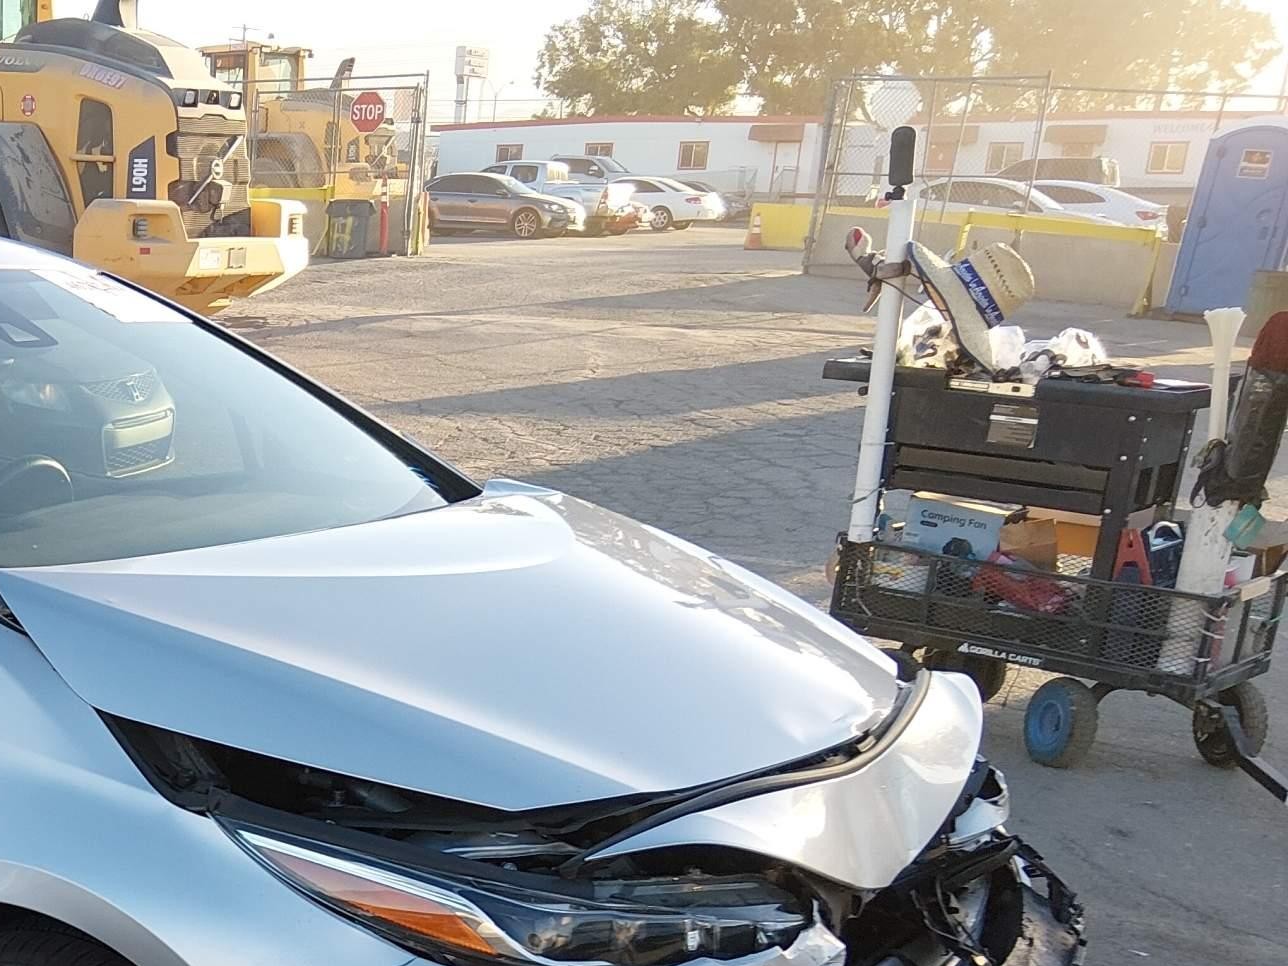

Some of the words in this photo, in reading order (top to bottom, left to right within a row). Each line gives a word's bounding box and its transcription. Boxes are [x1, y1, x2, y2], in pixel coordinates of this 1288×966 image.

[352, 104, 384, 121] STOP
[131, 158, 149, 192] L90H
[920, 509, 967, 528] Camping
[968, 518, 988, 530] Fan
[1008, 653, 1040, 666] CARTS
